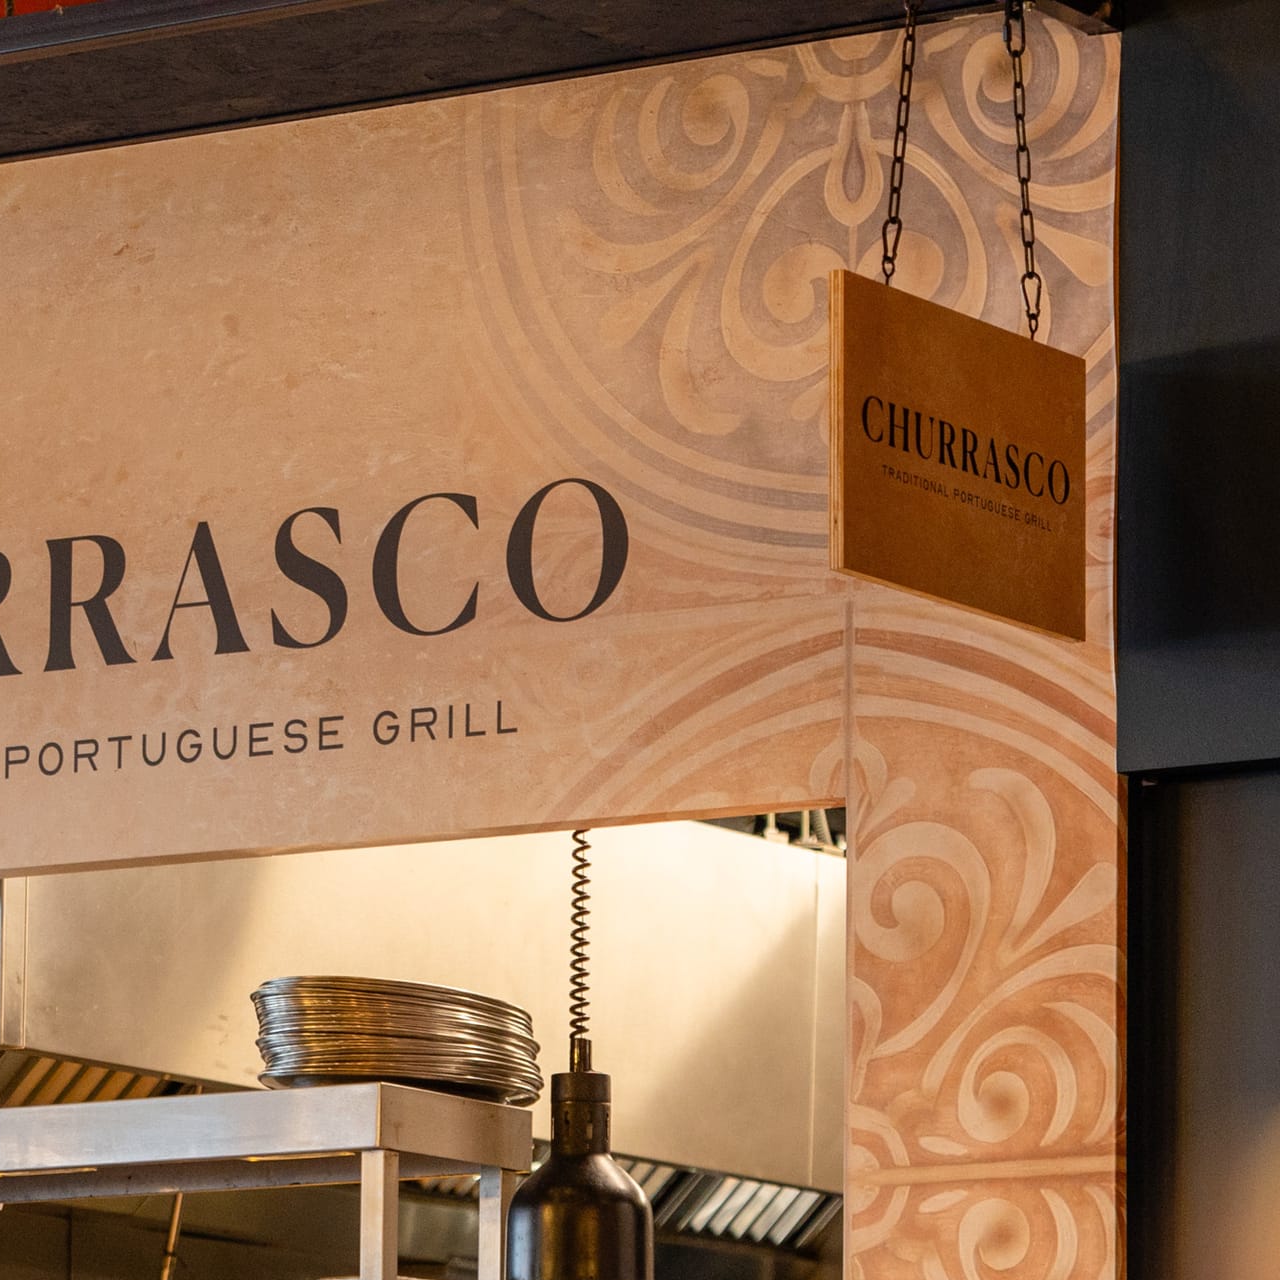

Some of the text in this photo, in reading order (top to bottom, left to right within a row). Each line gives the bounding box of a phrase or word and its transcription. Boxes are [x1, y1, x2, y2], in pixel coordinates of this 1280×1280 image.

[861, 395, 1071, 506] CHURRASCO
[881, 464, 1052, 532] TRADITIONAL PORTUGUESE GRILL
[4, 714, 345, 780] PORTUGUESE
[372, 699, 519, 747] GRILL
